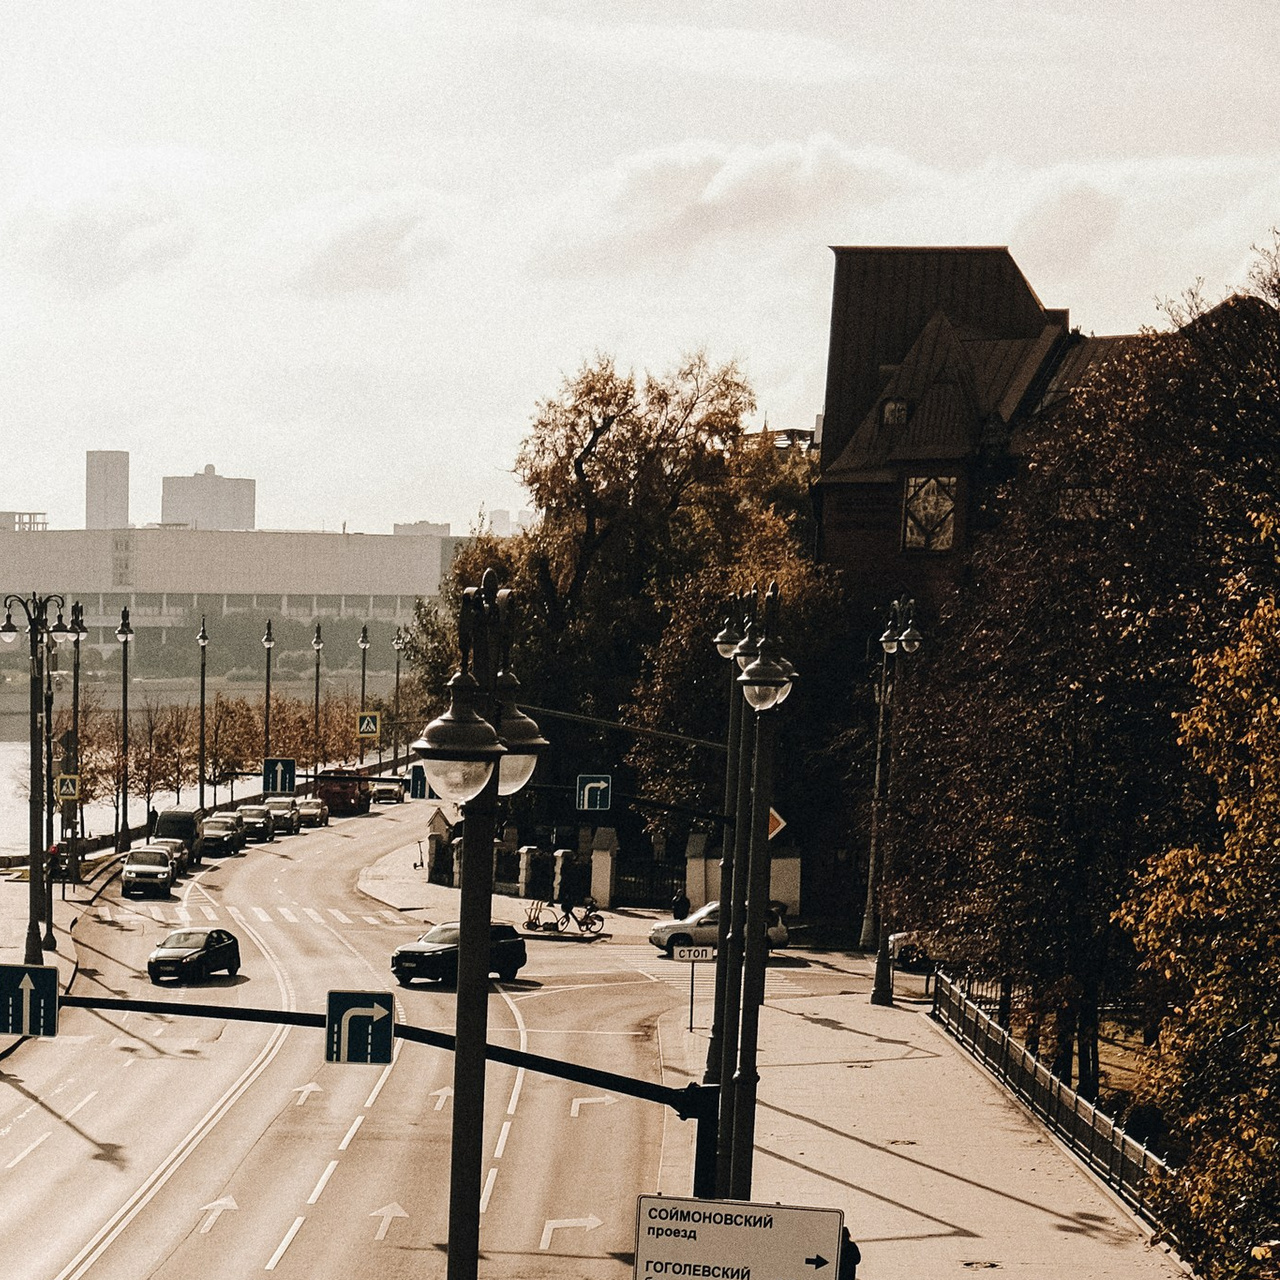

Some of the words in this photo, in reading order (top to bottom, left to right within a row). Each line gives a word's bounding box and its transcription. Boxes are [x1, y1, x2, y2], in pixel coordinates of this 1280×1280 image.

[678, 949, 708, 959] СТОП
[648, 1207, 773, 1229] СОЙМОНОВСКИЙ
[647, 1226, 697, 1240] проезд
[645, 1260, 751, 1280] ГОГОЛЕВСКИЙ
